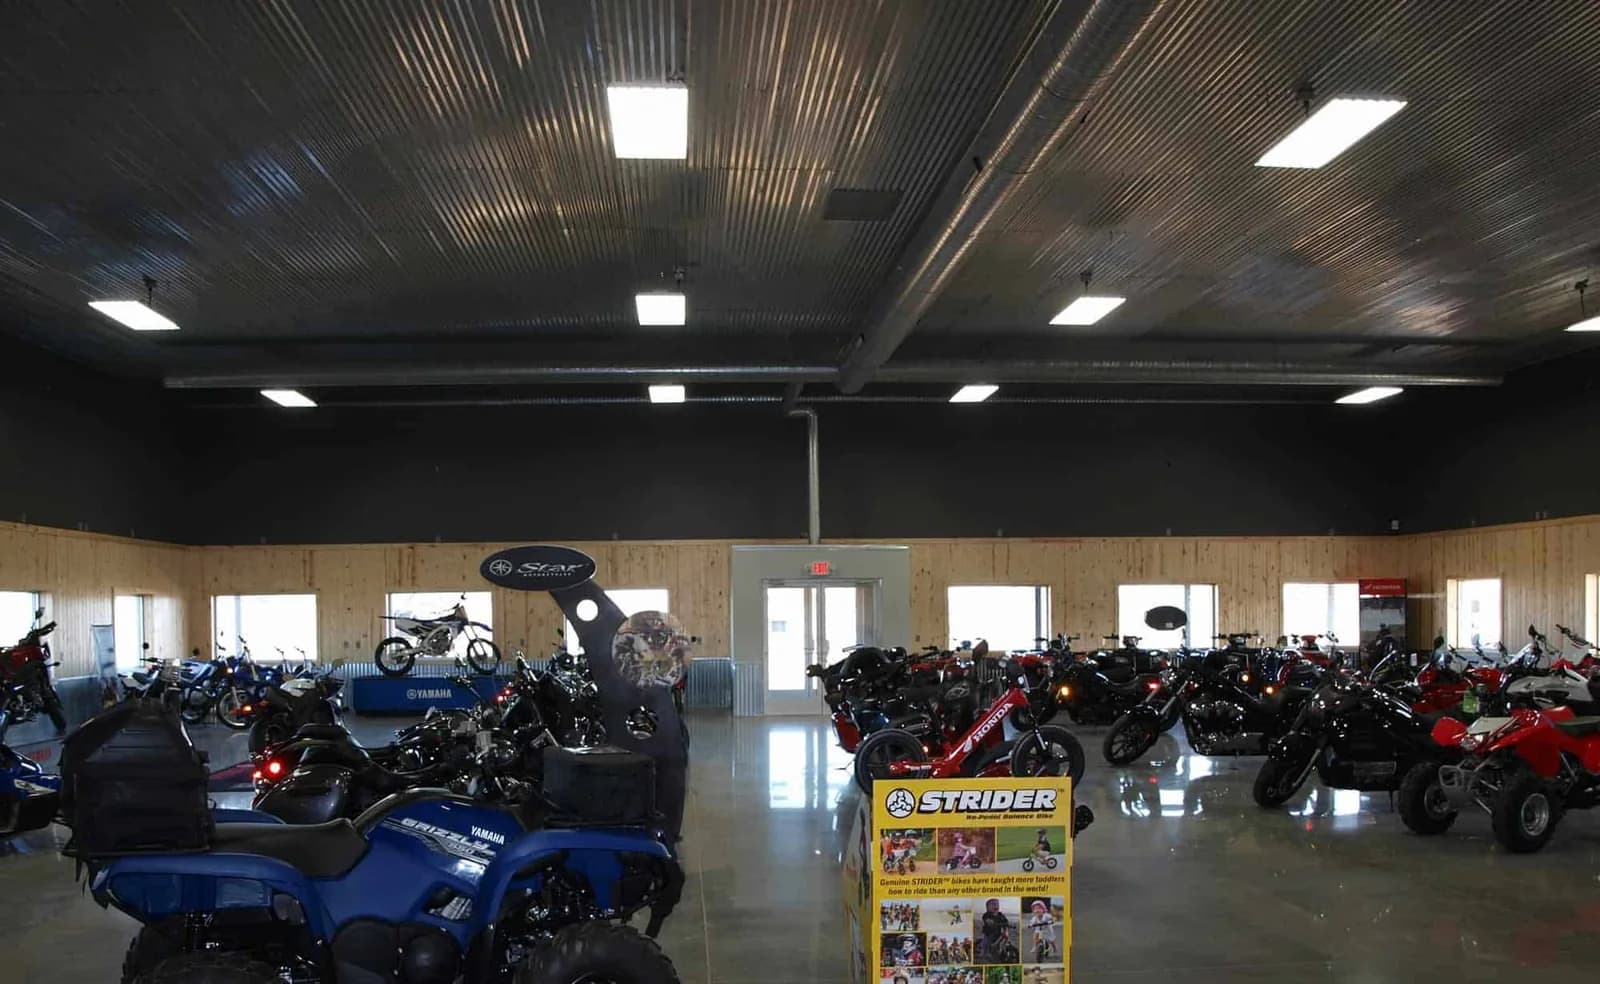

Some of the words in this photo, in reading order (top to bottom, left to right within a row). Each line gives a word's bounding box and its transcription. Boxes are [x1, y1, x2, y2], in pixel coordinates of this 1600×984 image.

[518, 562, 583, 573] Star
[416, 688, 452, 699] YAMAHA
[972, 703, 1014, 742] HONDA
[917, 788, 1057, 813] STRIDER
[400, 817, 491, 851] GRIZZLY
[471, 825, 505, 845] YAMAHA
[880, 878, 910, 886] Genuine
[951, 876, 971, 885] bikes
[990, 876, 1015, 885] taught
[888, 887, 904, 895] how
[904, 887, 912, 895] to
[913, 887, 928, 895] ride
[929, 887, 946, 895] than
[946, 888, 960, 896] any
[961, 886, 981, 894] other
[1026, 884, 1049, 892] world!
